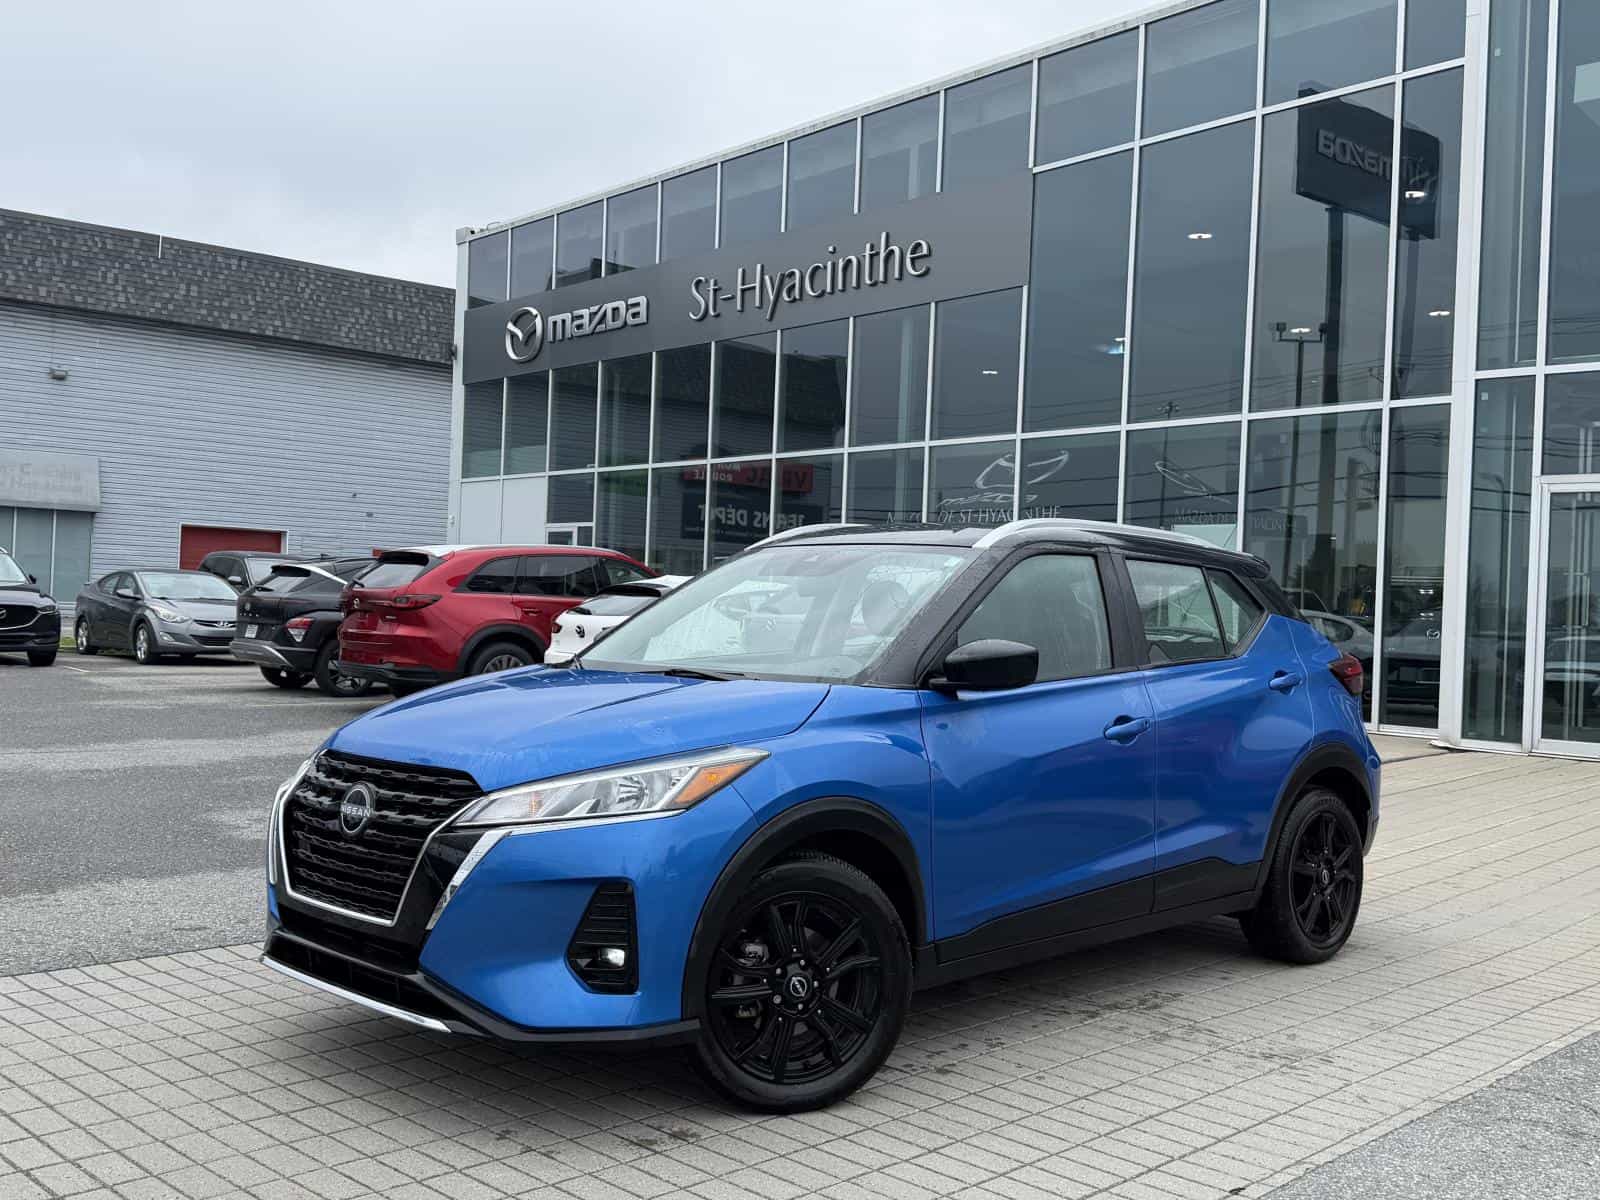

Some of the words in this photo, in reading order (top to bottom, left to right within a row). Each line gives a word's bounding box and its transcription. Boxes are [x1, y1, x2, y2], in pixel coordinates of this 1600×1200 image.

[548, 296, 648, 342] mazda
[688, 231, 931, 321] St-Hyacinthe
[958, 504, 1061, 524] ST-HYACNTHE
[341, 805, 370, 817] NISSAN
